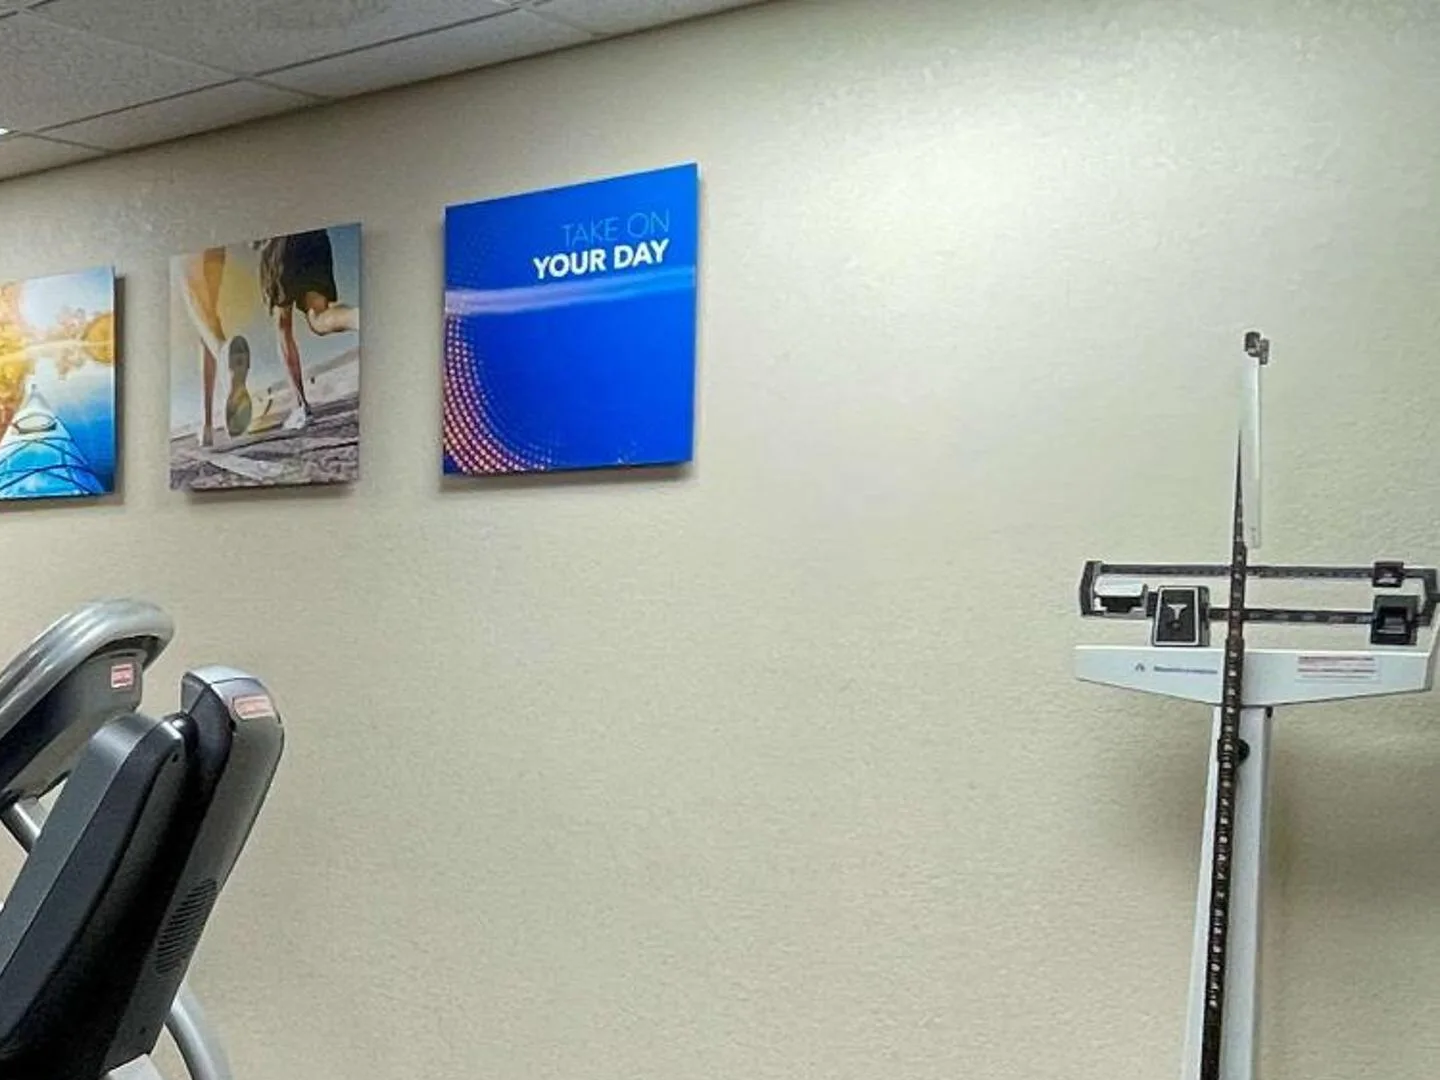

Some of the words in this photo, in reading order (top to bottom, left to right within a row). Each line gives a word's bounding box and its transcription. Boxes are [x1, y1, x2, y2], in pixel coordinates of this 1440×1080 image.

[562, 216, 620, 248] TAKE
[627, 208, 669, 238] ON
[533, 248, 606, 279] YOUR
[613, 238, 670, 269] DAY
